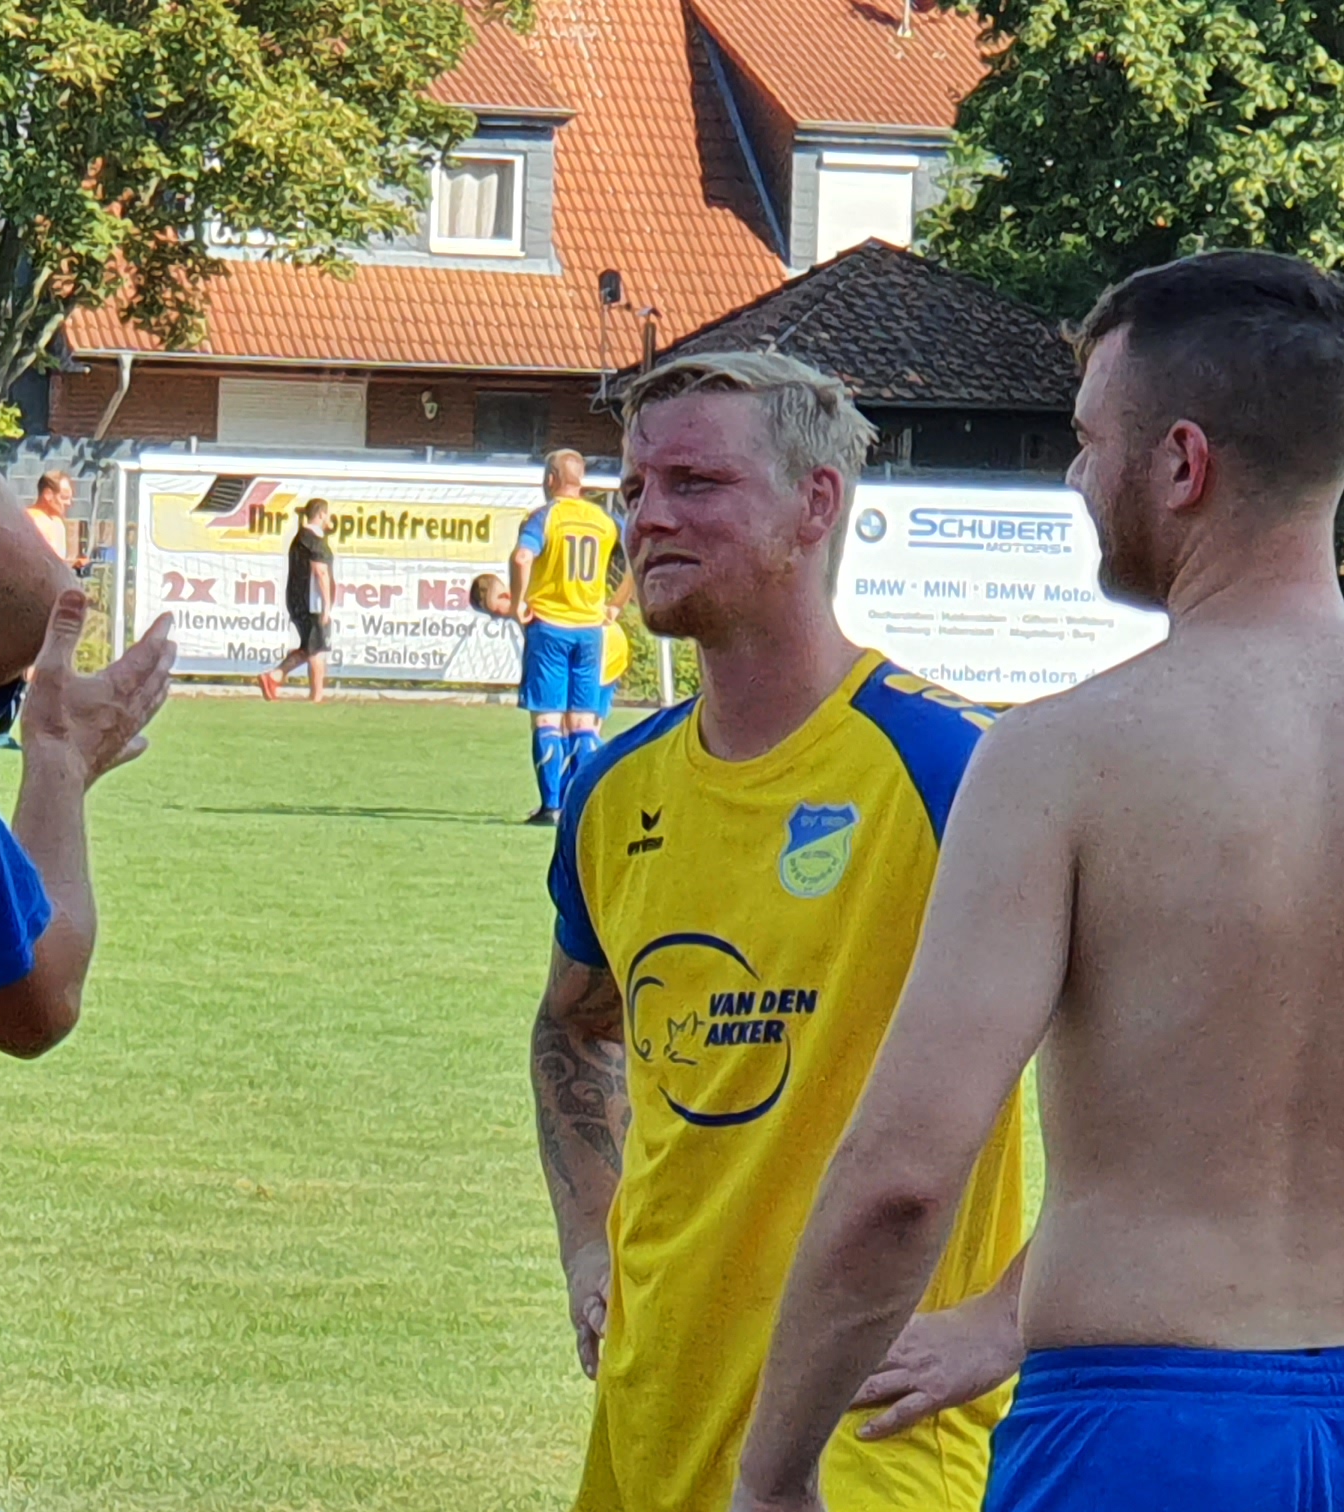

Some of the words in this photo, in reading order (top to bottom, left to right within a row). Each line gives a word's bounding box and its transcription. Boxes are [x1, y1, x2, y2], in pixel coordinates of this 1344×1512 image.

[248, 503, 289, 536] Ihr
[294, 505, 492, 544] Tppichfreund
[908, 507, 1073, 542] SCHUBERT
[564, 535, 598, 582] 10
[986, 542, 1062, 554] MOTORS
[161, 571, 219, 604] 2x
[234, 572, 276, 605] in
[335, 583, 404, 609] rer
[855, 578, 906, 597] BMW
[924, 580, 967, 599] MINI
[985, 582, 1036, 601] BMW
[709, 990, 756, 1018] VAN
[759, 988, 818, 1015] DEN
[704, 1019, 785, 1048] AKKER
